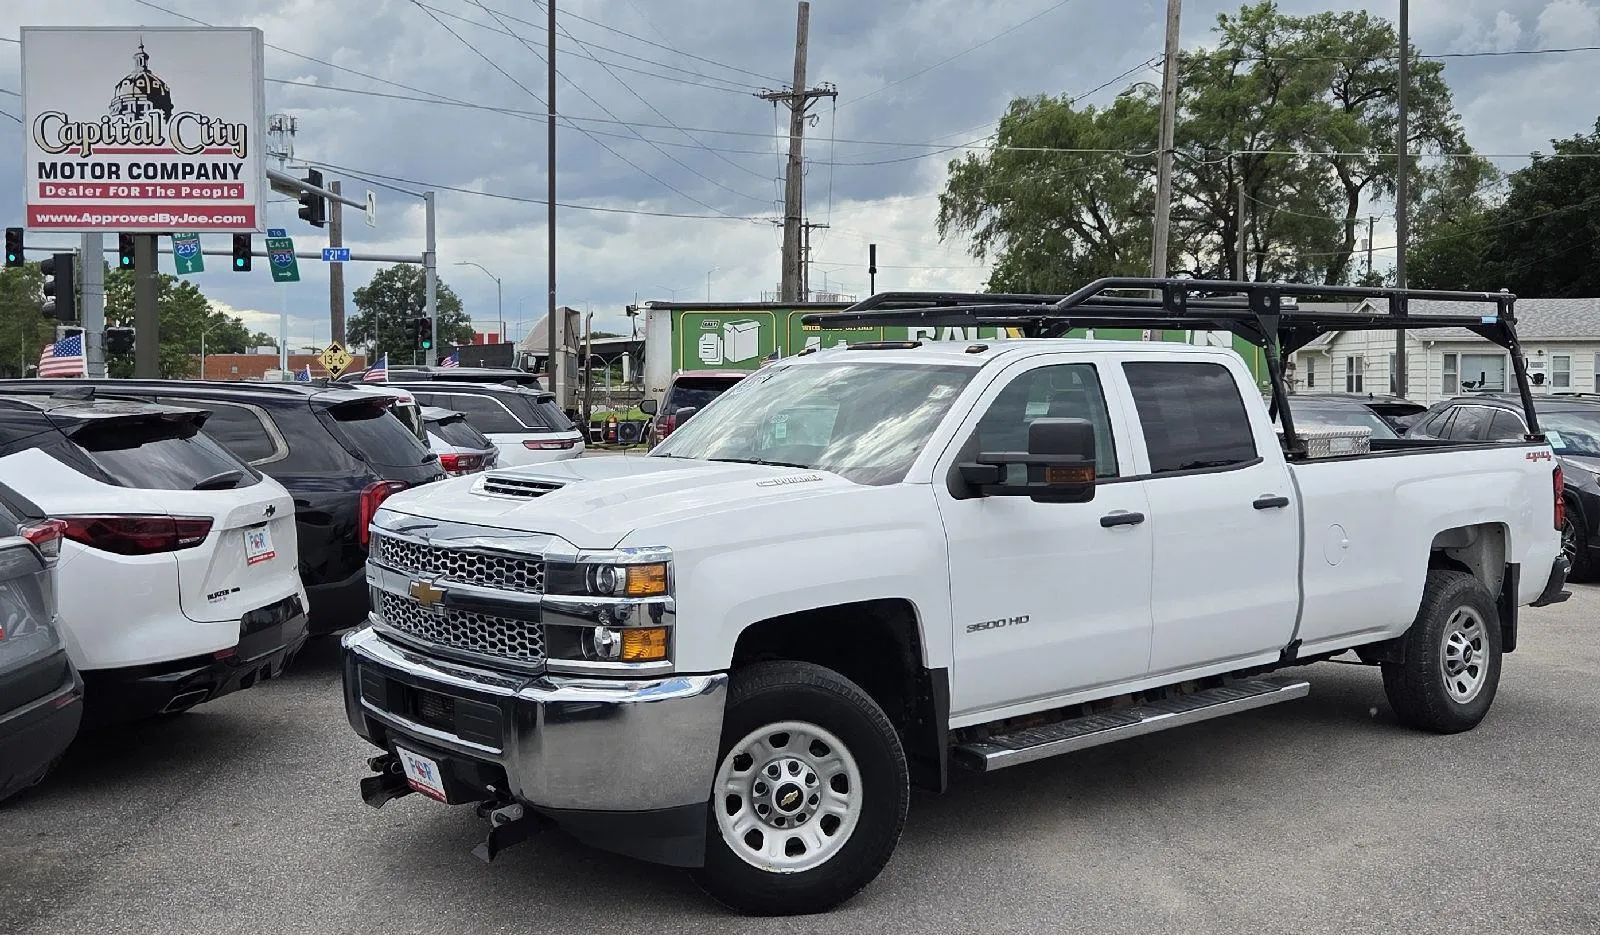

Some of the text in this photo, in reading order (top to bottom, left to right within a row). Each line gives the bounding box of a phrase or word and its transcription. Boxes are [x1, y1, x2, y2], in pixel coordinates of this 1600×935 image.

[33, 111, 247, 159] Capital City
[38, 162, 243, 180] MOTOR COMPANY
[45, 185, 239, 199] Dealer FOR The People
[36, 212, 246, 225] www.ApprovedByJoe.com
[178, 243, 197, 254] 235
[268, 240, 289, 248] EAST
[273, 254, 292, 263] 235
[966, 615, 1029, 633] 3500 HD
